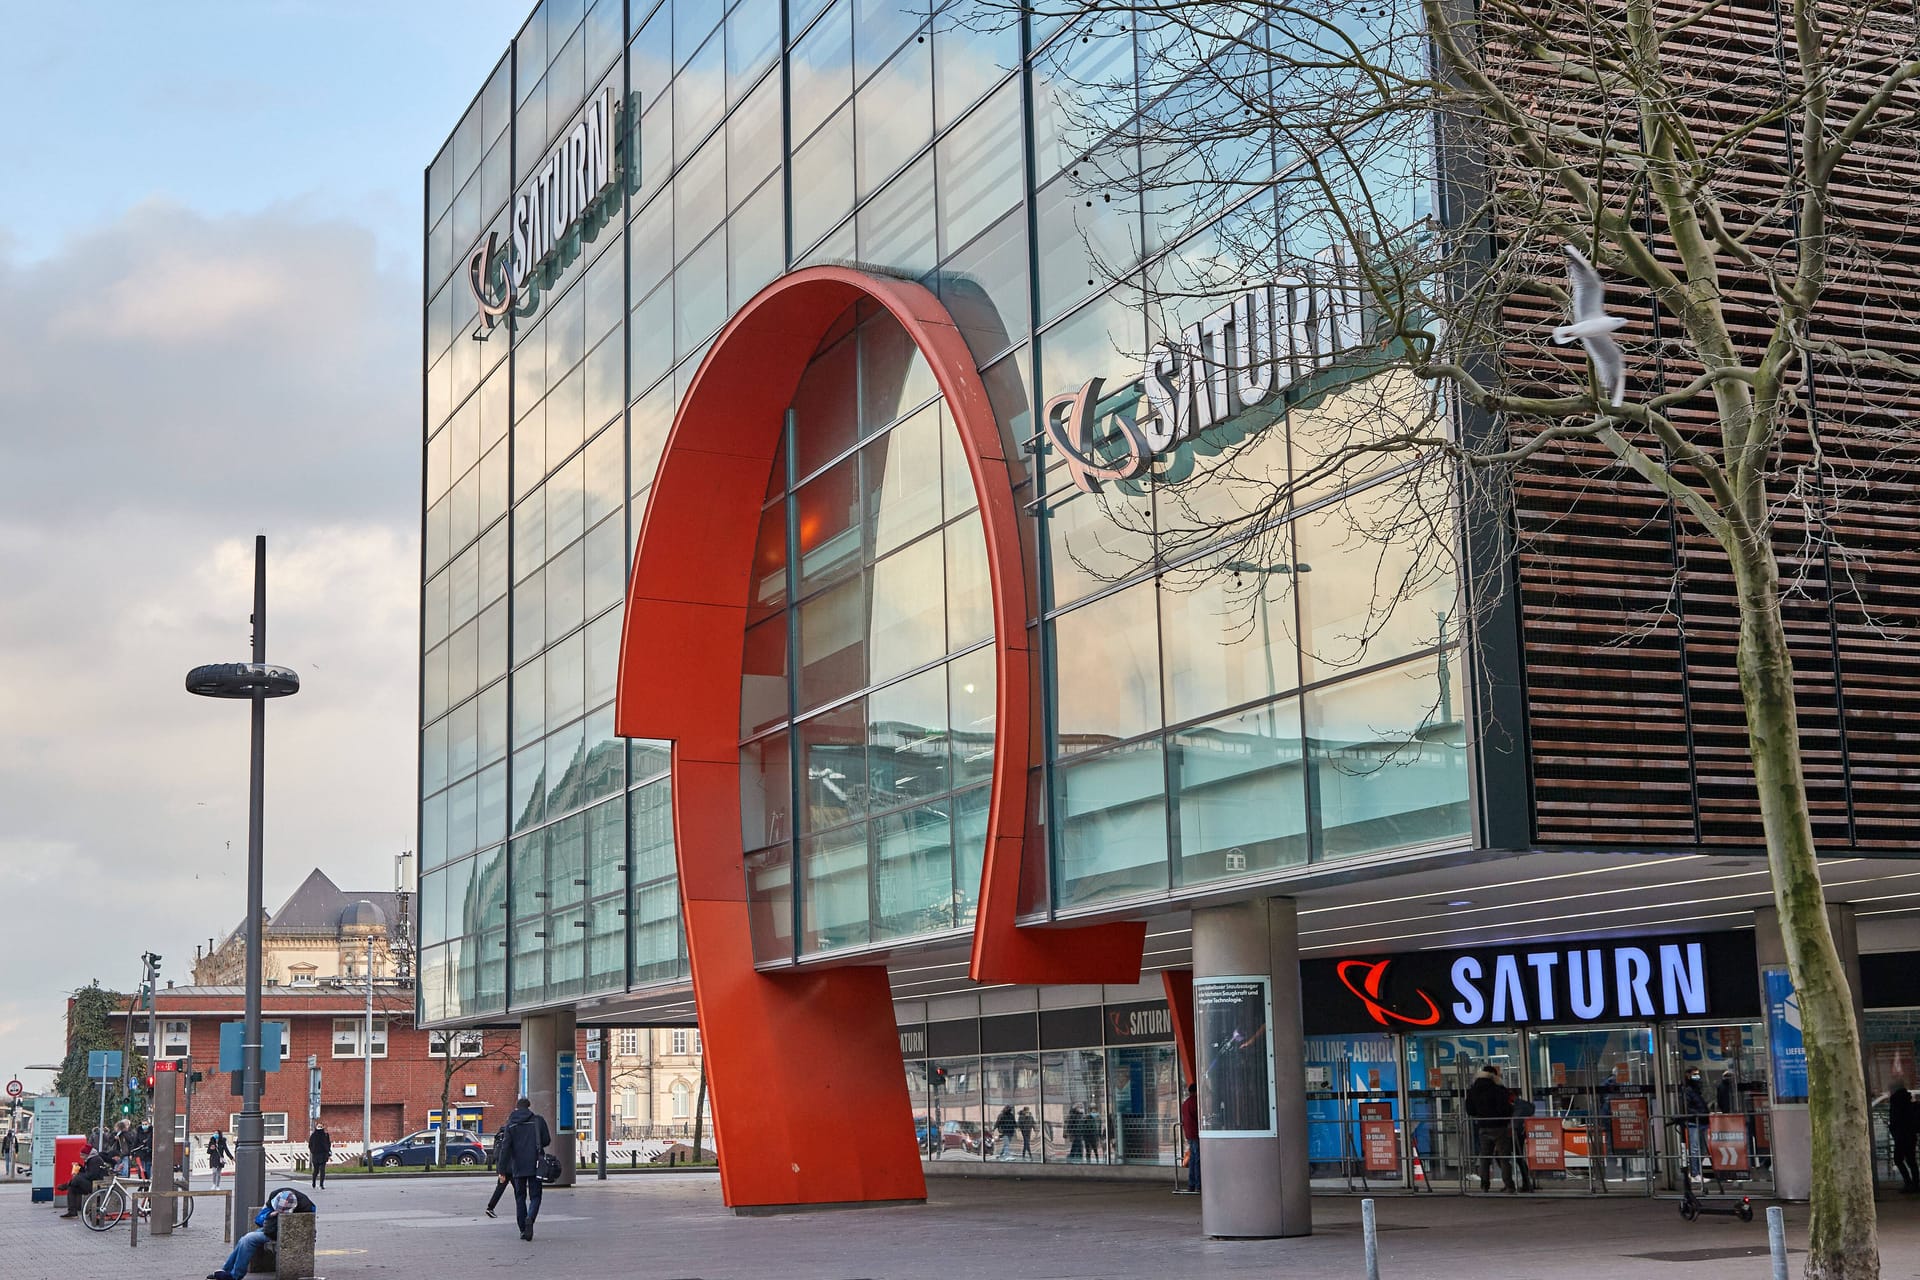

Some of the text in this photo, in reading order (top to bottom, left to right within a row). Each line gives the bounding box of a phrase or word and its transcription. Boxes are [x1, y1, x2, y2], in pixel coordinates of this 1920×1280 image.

[513, 87, 615, 288] SATURN
[1144, 240, 1370, 453] SATURN
[1130, 1009, 1171, 1035] SATURN
[1451, 943, 1707, 1025] SATURN
[898, 1031, 924, 1053] ATURN
